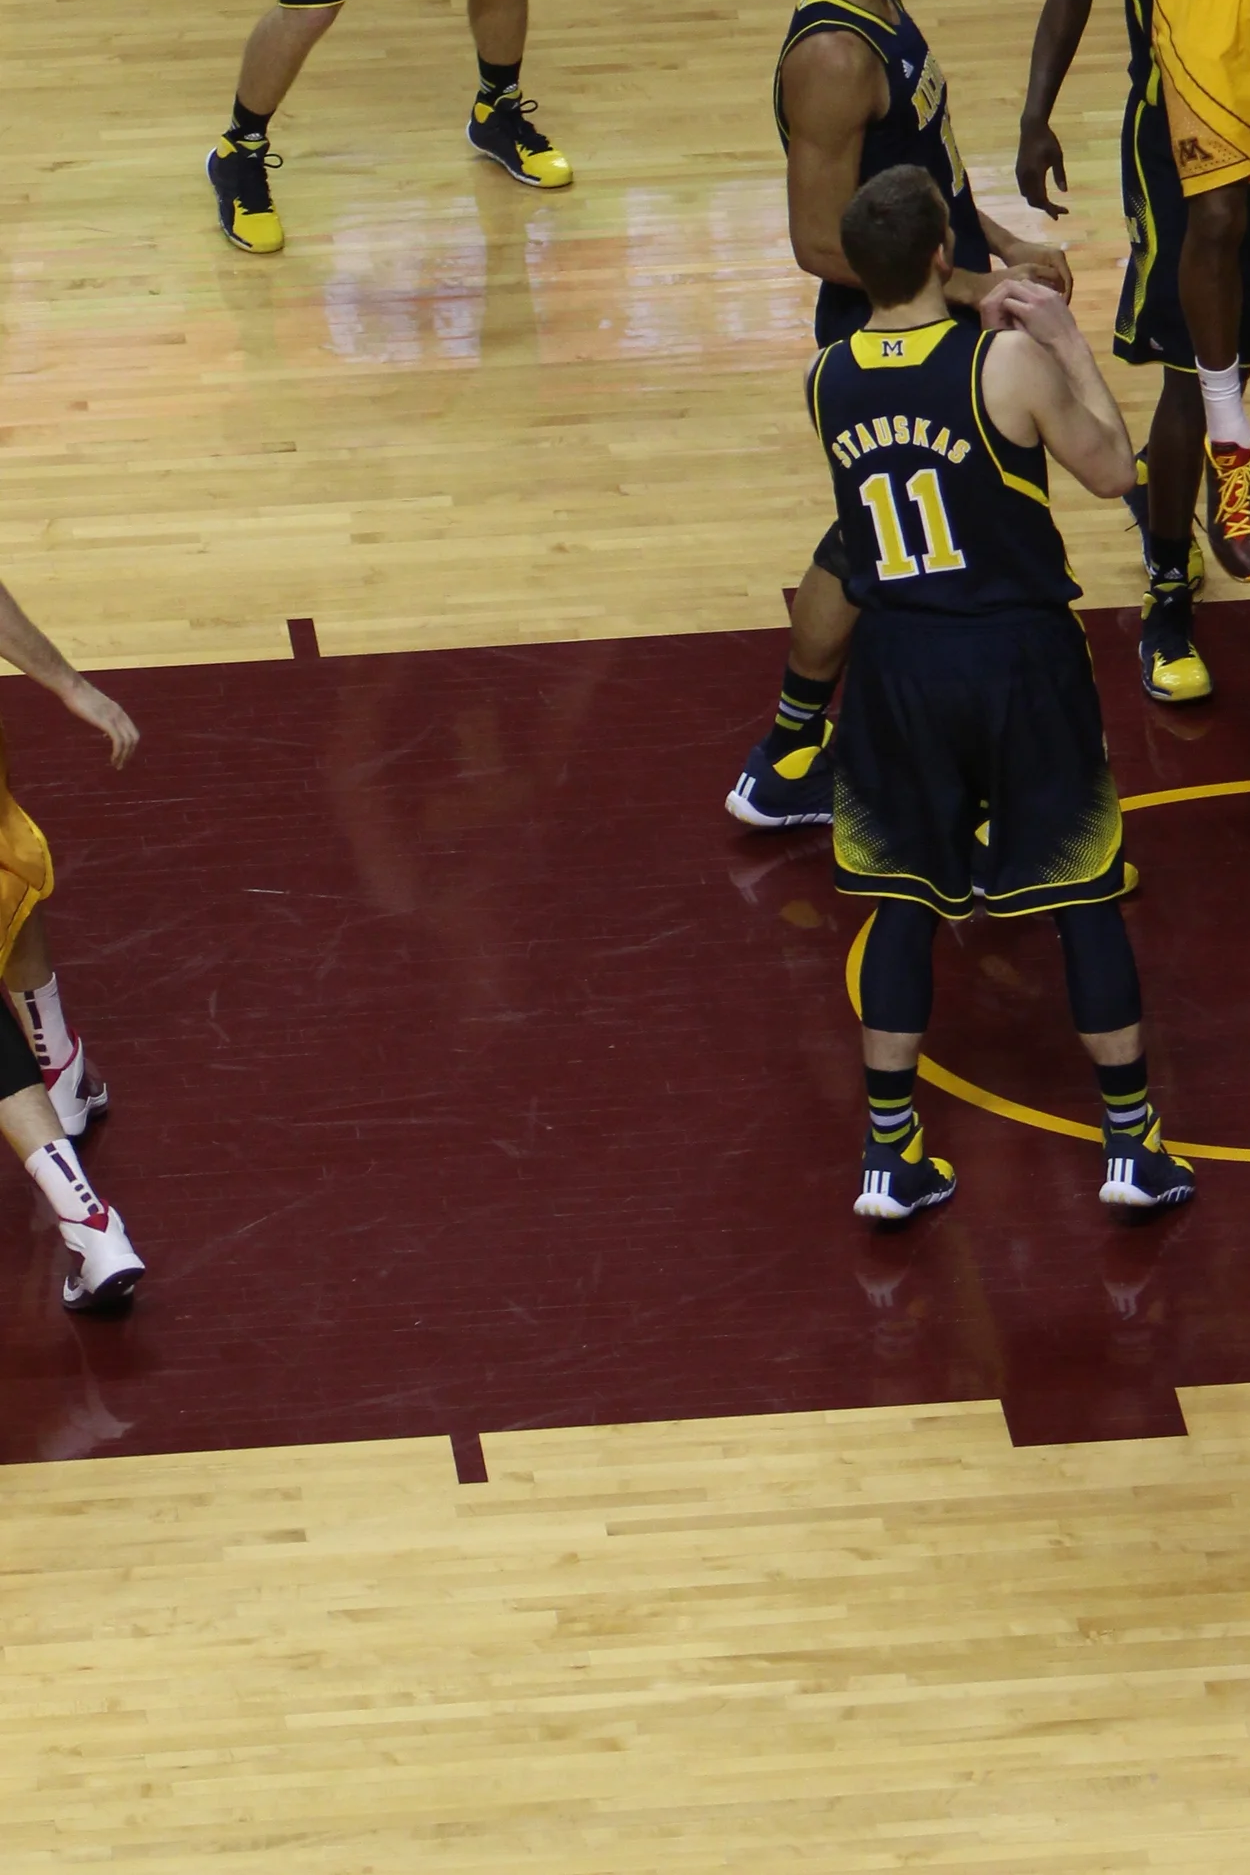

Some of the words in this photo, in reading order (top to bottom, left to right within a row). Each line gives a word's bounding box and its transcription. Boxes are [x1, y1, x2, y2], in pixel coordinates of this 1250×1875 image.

[881, 339, 904, 357] M
[831, 414, 972, 469] STAUSKAS
[859, 468, 967, 581] 11
